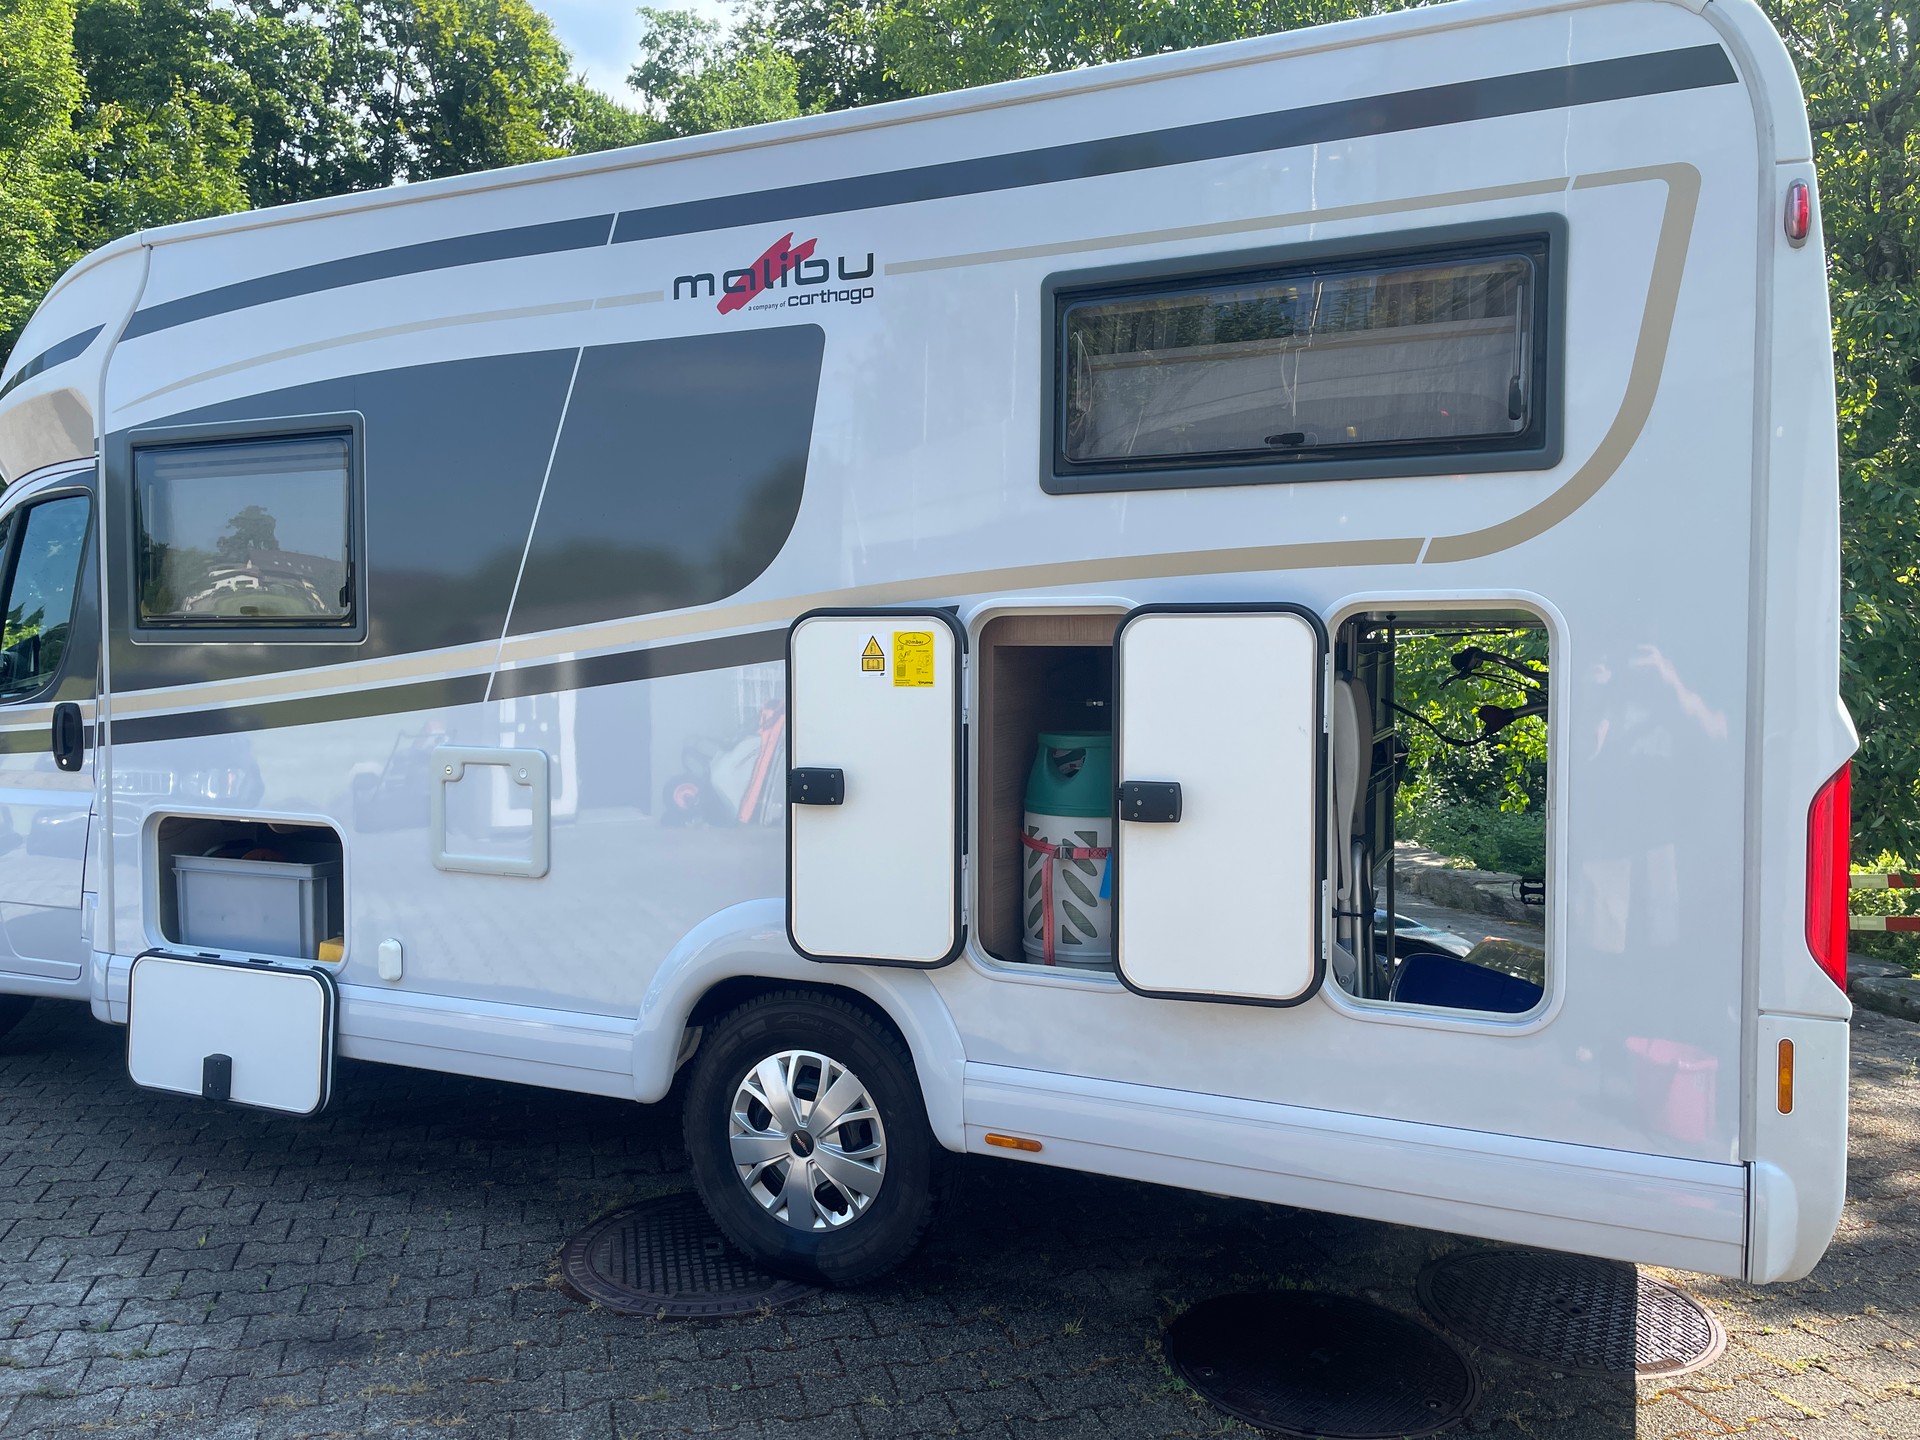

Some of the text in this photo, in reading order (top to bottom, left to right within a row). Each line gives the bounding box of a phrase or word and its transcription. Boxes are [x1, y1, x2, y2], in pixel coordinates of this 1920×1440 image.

[674, 252, 874, 300] malibu
[753, 302, 778, 311] company
[788, 287, 874, 307] carthago
